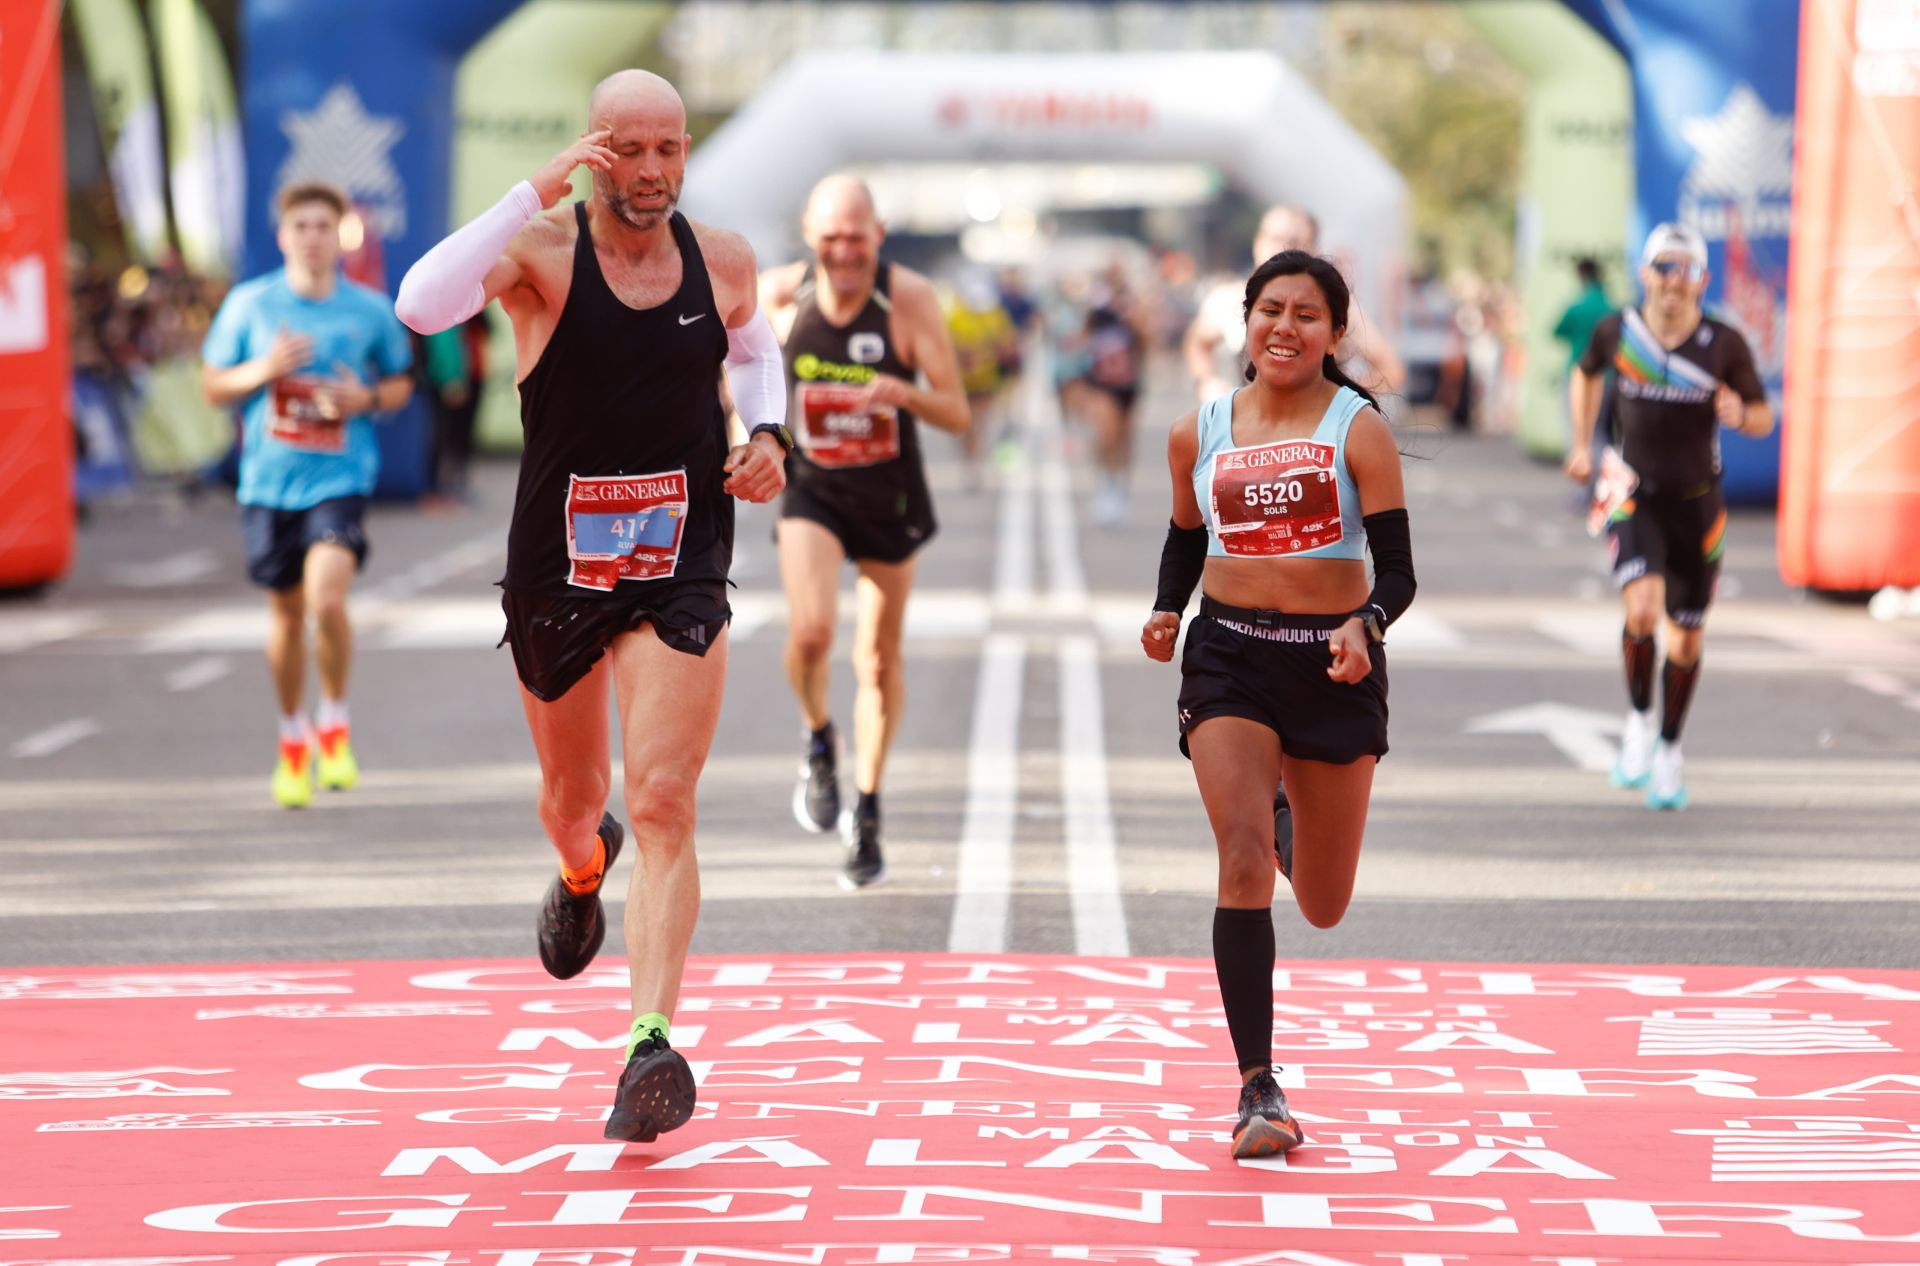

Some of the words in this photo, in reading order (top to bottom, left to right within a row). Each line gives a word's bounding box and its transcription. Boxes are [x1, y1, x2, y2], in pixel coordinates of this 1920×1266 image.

[1247, 445, 1327, 468] GENERALI
[600, 479, 680, 501] GENERALI
[1244, 481, 1303, 506] 5520
[1263, 506, 1288, 515] SOLIS
